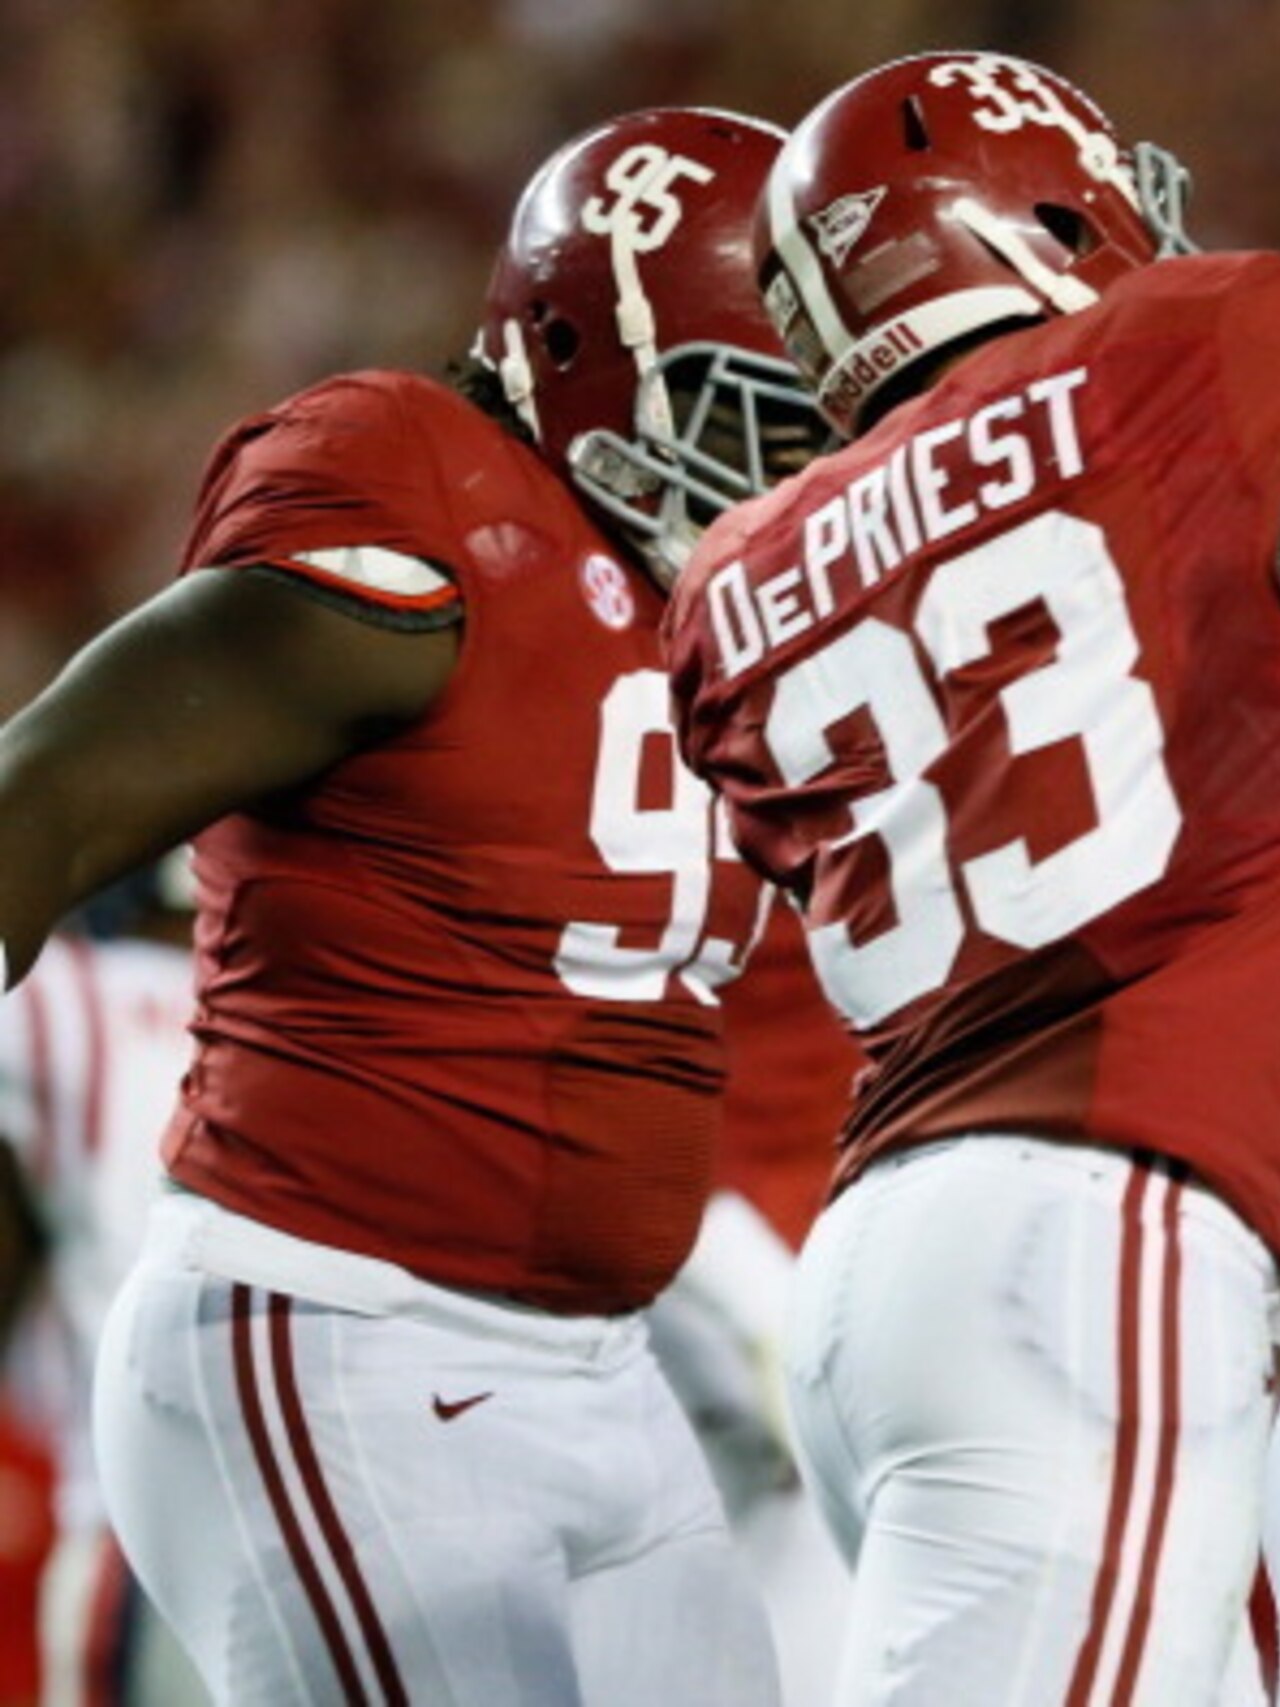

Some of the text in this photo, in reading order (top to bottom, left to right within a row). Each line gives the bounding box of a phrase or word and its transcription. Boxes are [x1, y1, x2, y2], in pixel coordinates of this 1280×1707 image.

[927, 57, 1068, 133] 33
[581, 144, 716, 255] 95
[766, 509, 1184, 1032] 33
